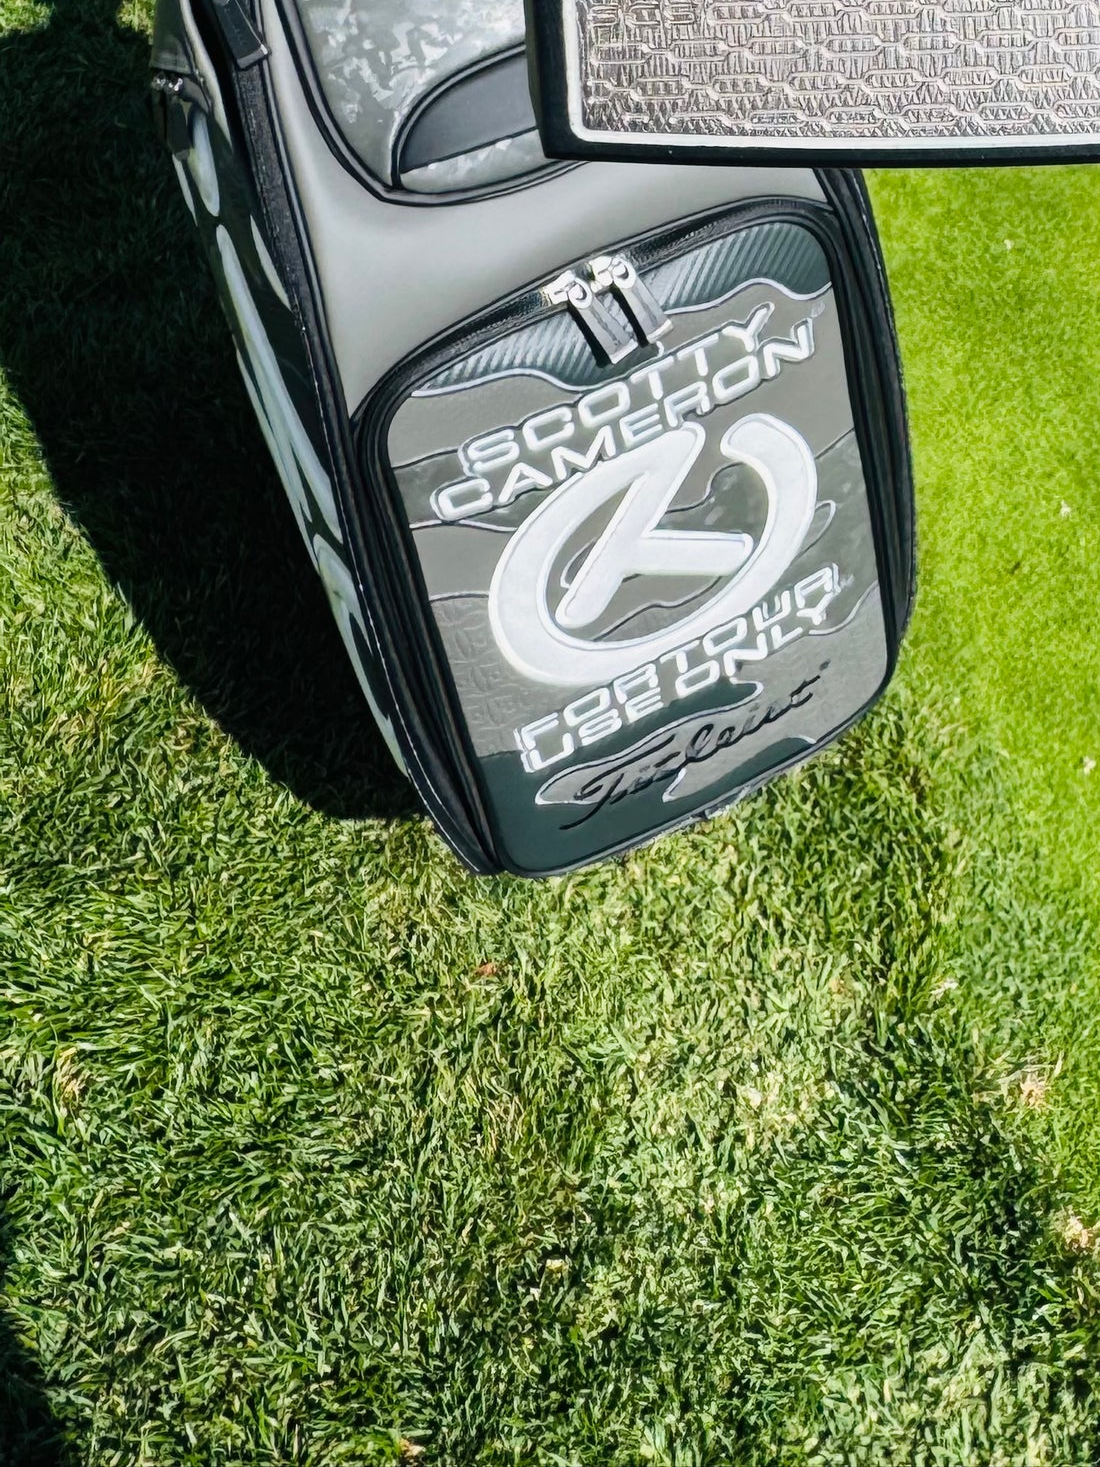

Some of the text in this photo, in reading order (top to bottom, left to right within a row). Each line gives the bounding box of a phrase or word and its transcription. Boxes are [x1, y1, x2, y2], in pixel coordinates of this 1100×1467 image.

[431, 318, 815, 522] CAMERON
[459, 303, 775, 476] SCOTTY
[513, 564, 839, 750] FOR TOUR
[520, 601, 826, 772] USE ONLY
